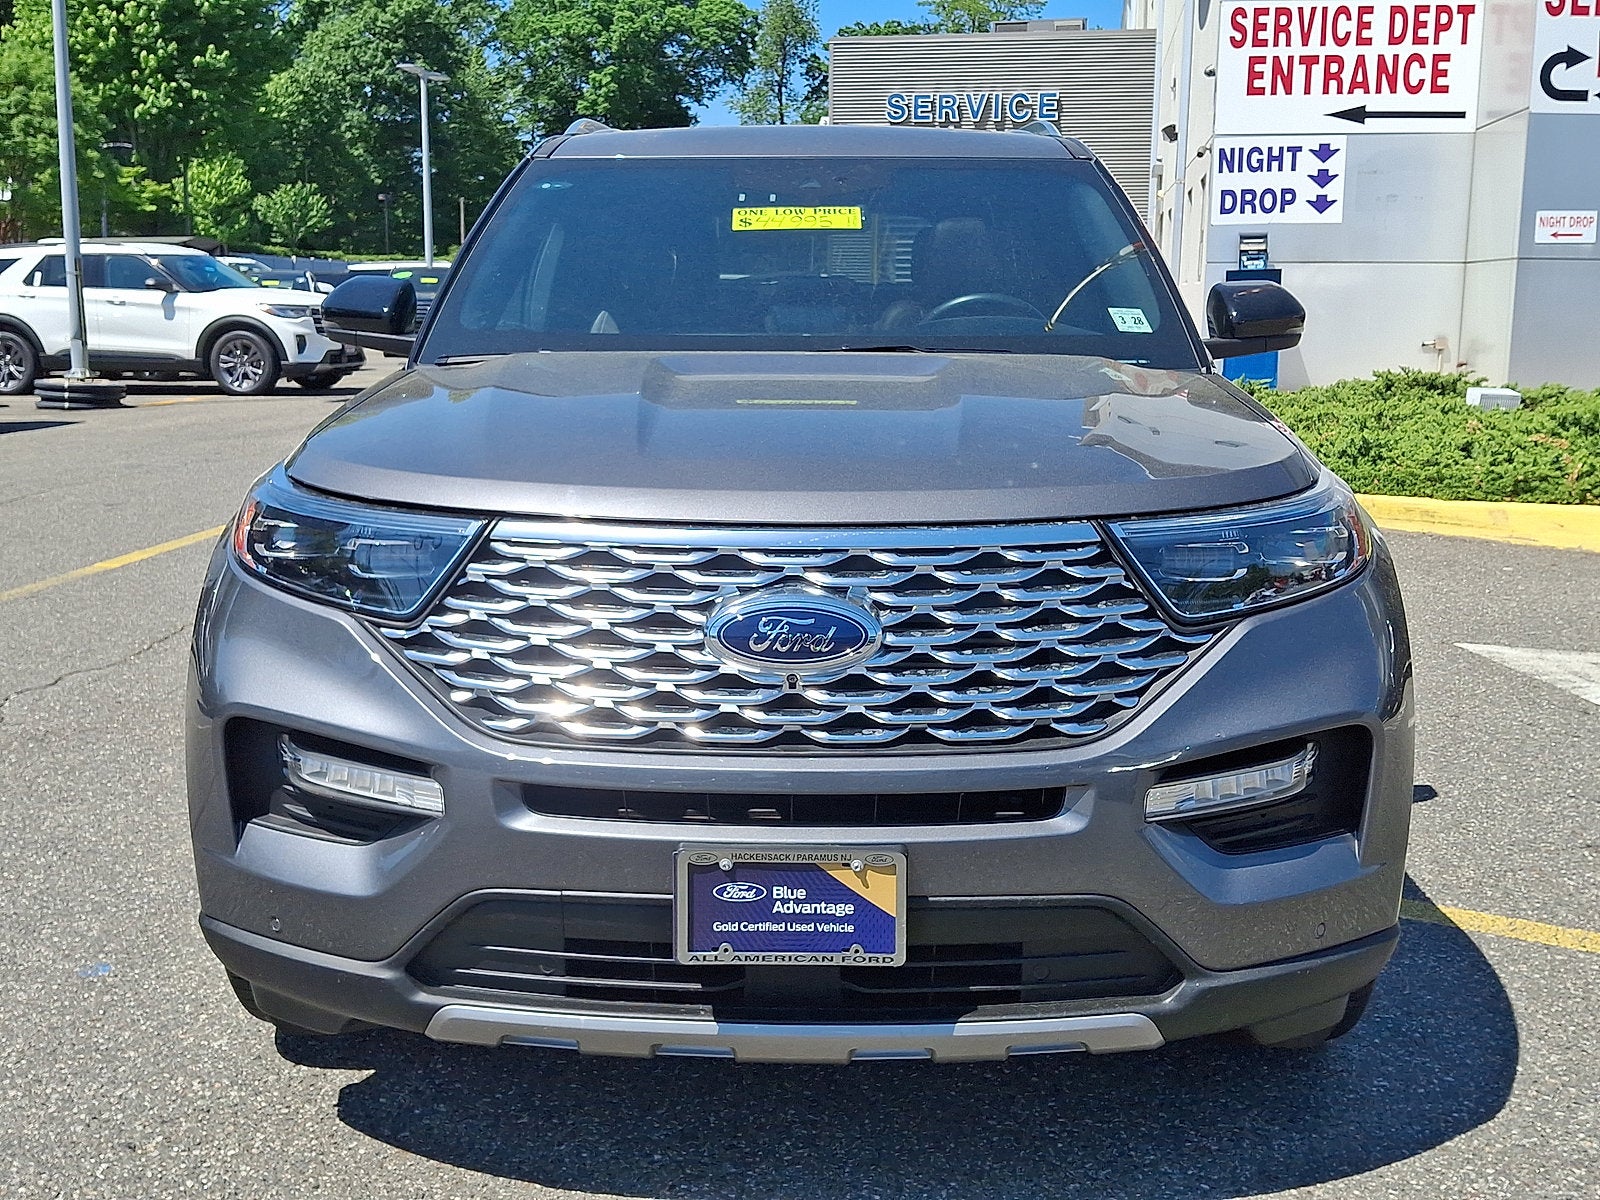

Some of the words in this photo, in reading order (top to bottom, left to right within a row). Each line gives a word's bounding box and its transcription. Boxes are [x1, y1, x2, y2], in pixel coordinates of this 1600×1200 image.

[1229, 6, 1374, 48] SERVICE
[1388, 4, 1476, 46] DEPT
[1246, 53, 1452, 96] ENTRANCE
[885, 91, 1059, 122] SERVICE
[1218, 145, 1302, 173] NIGHT
[1219, 188, 1297, 215] DROP
[775, 208, 806, 216] LOW
[1539, 216, 1567, 228] NIGHT
[1569, 216, 1595, 228] DROP
[1118, 315, 1127, 325] 3
[1130, 316, 1145, 325] 28
[749, 616, 837, 652] Ford
[731, 852, 791, 861] HACKENSACK
[797, 853, 839, 862] PARAMUS
[841, 854, 852, 862] NJ
[722, 885, 757, 899] Ford
[772, 886, 806, 899] Blue
[772, 901, 855, 917] Advantage
[712, 922, 738, 932] Gold
[740, 922, 785, 932] Certified
[787, 922, 814, 932] Used
[816, 922, 855, 933] Vehicle
[689, 955, 724, 963] ALL
[731, 955, 835, 964] AMERICAN
[842, 956, 895, 964] FORD
